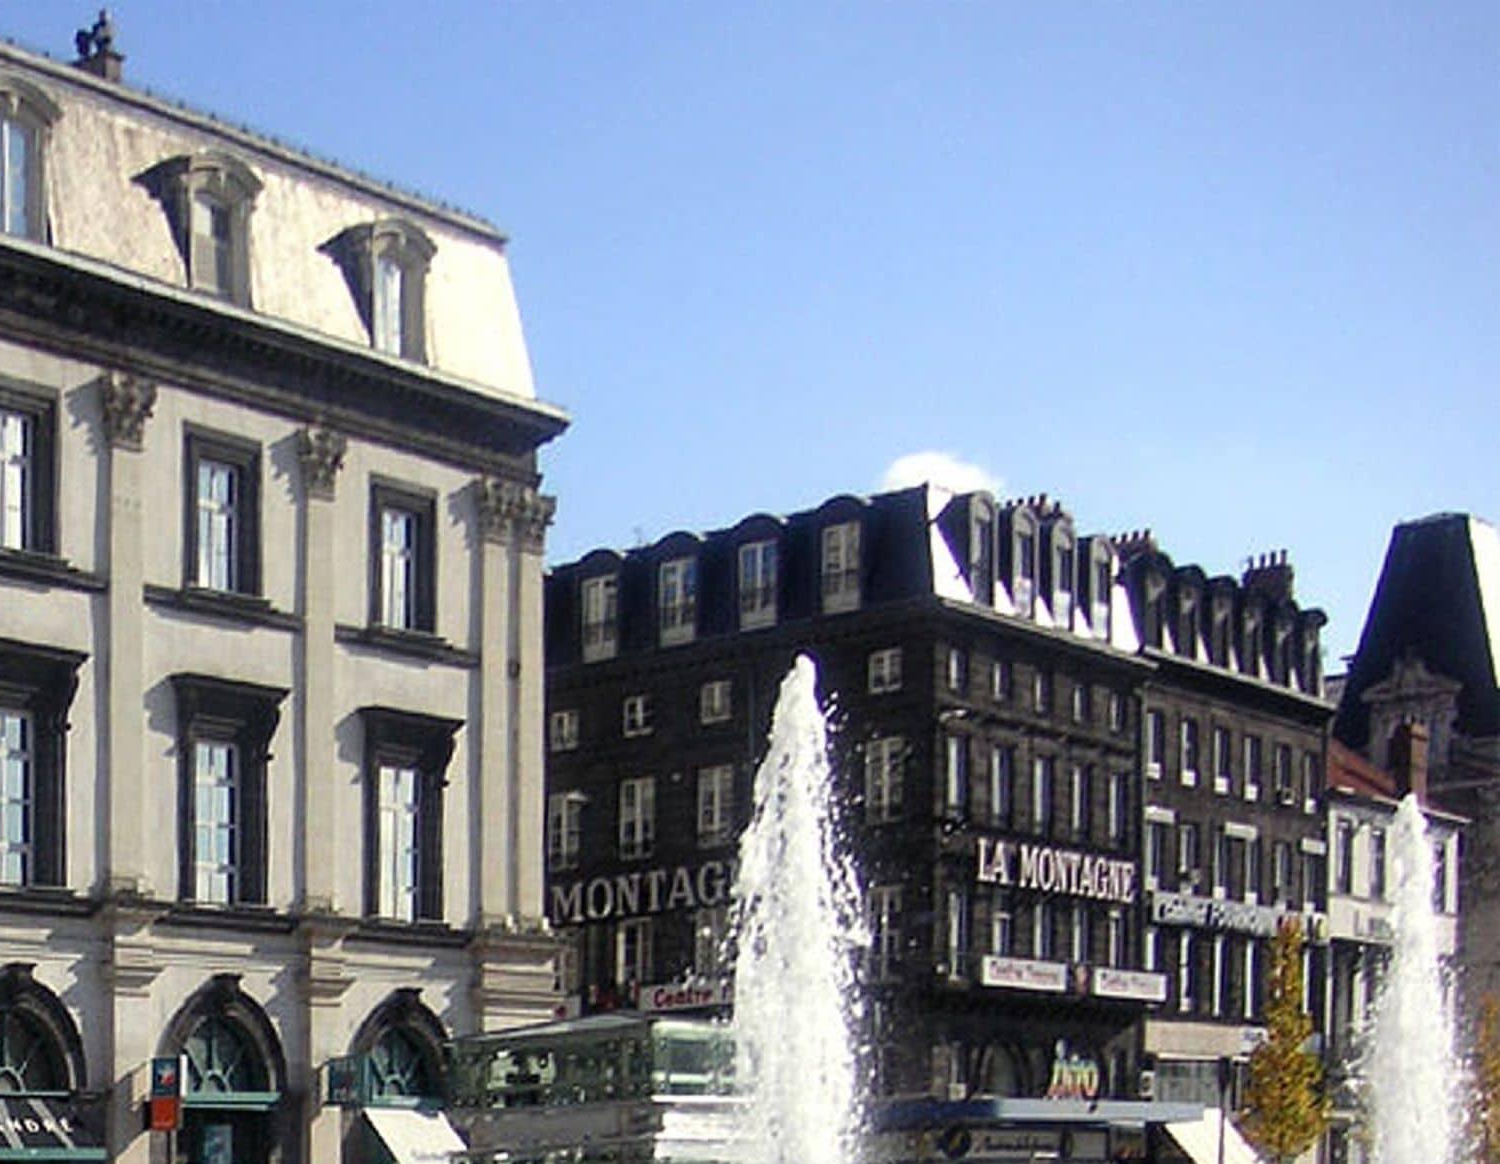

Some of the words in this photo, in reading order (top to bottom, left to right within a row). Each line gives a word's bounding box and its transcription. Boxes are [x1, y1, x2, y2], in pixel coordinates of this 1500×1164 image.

[551, 861, 738, 925] MONTAG
[977, 837, 1015, 885] LA
[1019, 844, 1135, 903] MONTAGNE
